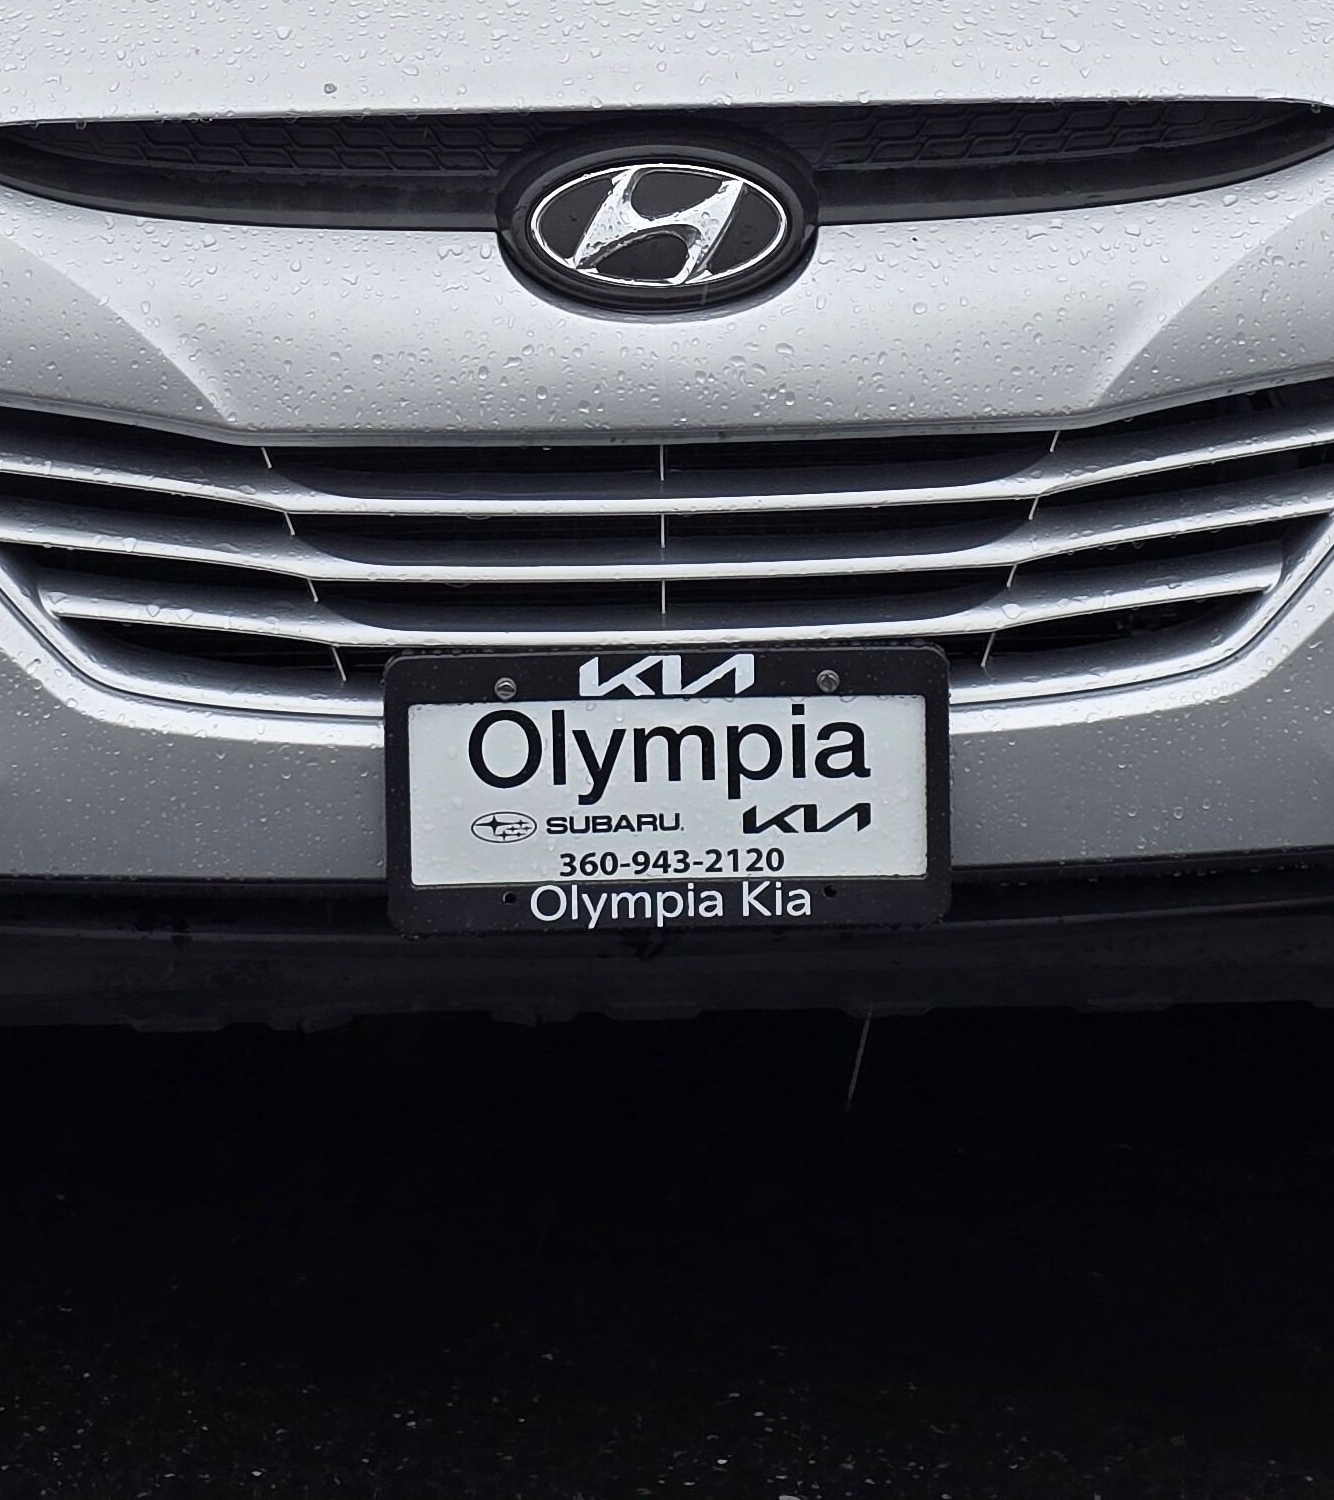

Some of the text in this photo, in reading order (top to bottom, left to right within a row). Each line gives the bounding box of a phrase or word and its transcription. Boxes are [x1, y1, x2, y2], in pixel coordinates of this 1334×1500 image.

[467, 704, 871, 805] Olympia
[546, 813, 682, 835] SUBARU
[559, 847, 785, 877] 360-943-2120
[530, 880, 812, 929] Olympia Kia
